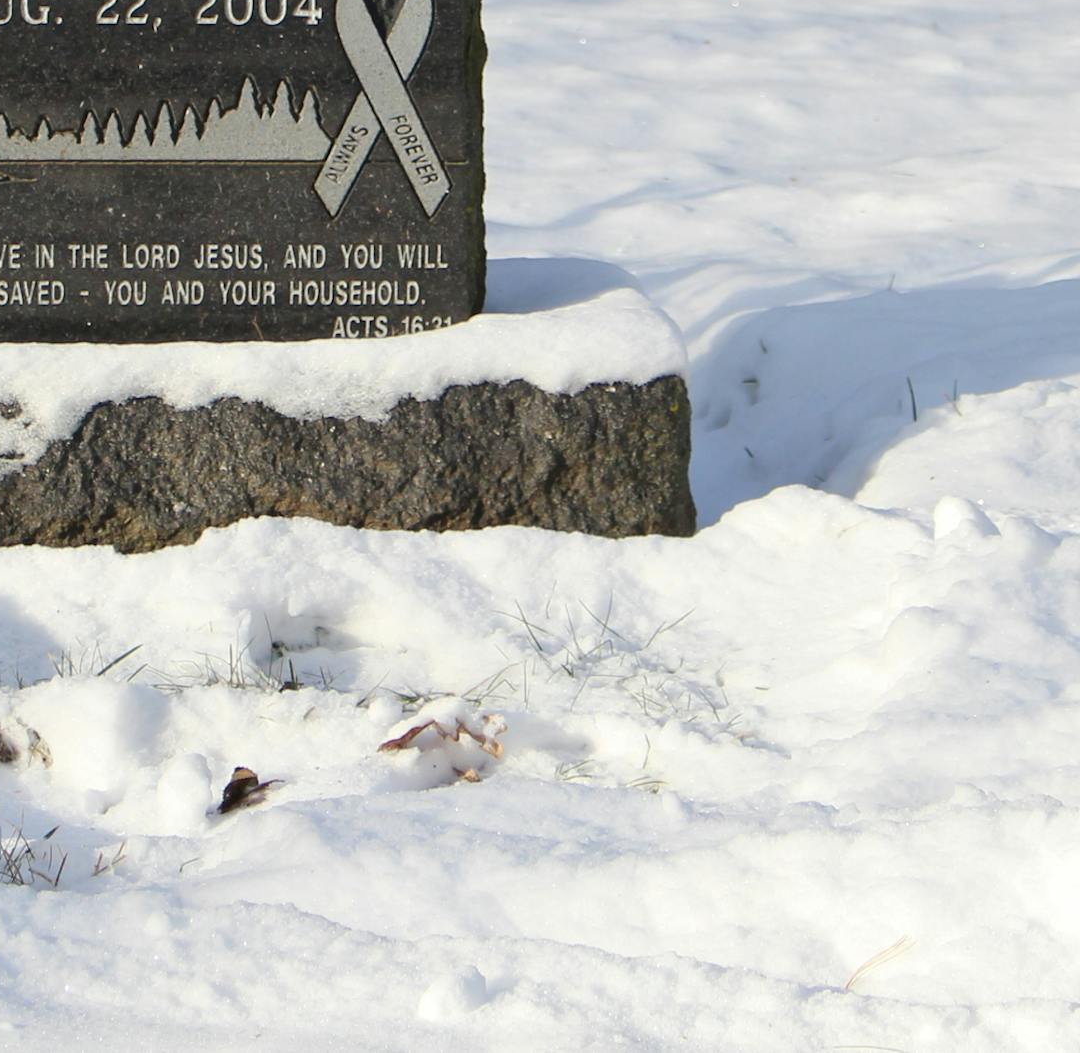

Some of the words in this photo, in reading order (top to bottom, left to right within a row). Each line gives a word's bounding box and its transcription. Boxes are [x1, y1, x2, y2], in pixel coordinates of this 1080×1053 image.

[325, 126, 369, 184] ALWAYS
[390, 115, 439, 185] FOREVER
[35, 245, 55, 269] IN
[68, 245, 108, 269] THE
[122, 245, 180, 269] LORD
[194, 245, 269, 272] JESUS,
[283, 245, 326, 269] AND
[341, 245, 383, 269] YOU
[398, 245, 449, 269] WILL
[104, 281, 147, 305] YOU
[161, 281, 204, 305] AND
[220, 281, 276, 305] YOUR
[289, 281, 426, 306] HOUSEHOLD.
[332, 316, 388, 338] ACTS
